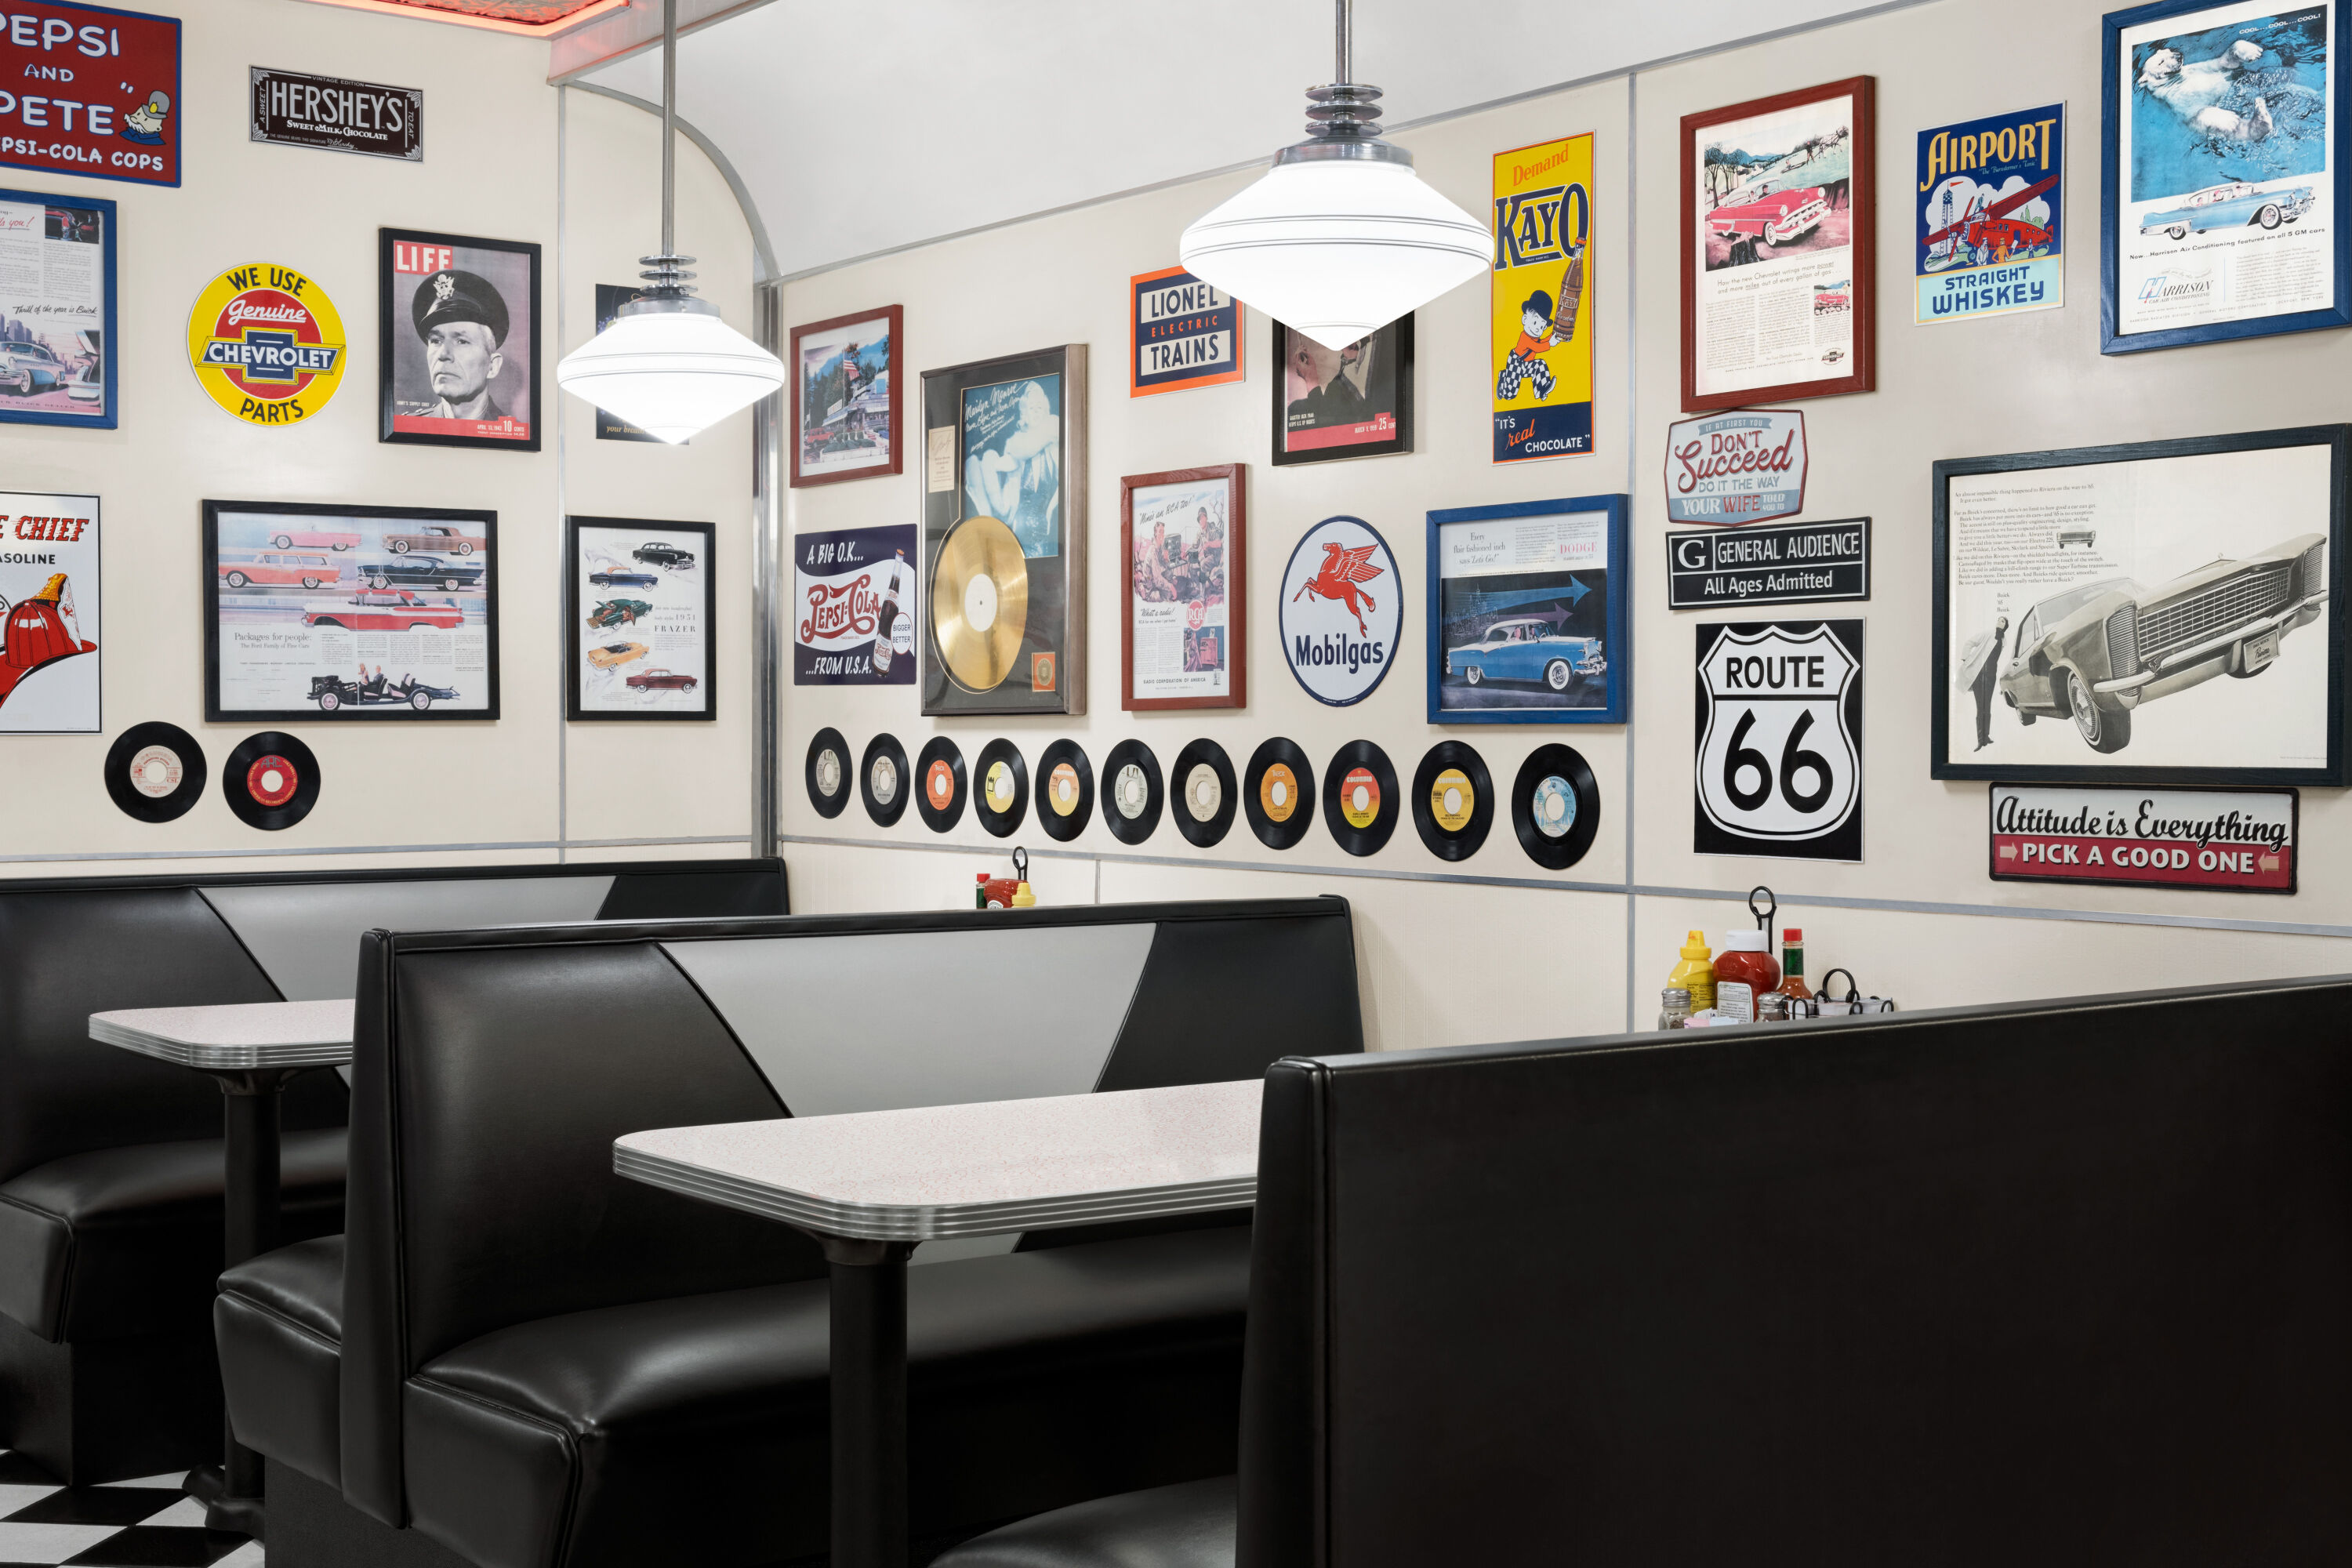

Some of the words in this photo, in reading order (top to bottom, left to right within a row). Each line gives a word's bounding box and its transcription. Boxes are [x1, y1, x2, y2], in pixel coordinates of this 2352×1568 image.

[0, 12, 119, 57] EPSI
[24, 64, 74, 82] AND
[312, 75, 338, 84] VINTAGE
[271, 81, 403, 132] HERSHEY'S
[408, 111, 414, 122] TO
[287, 120, 314, 130] SWEET
[314, 124, 342, 134] MILK
[343, 127, 388, 140] CHOCOLATE
[0, 136, 102, 164] PSI-COLA
[111, 151, 163, 171] COPS
[1512, 143, 1569, 187] Demand
[1919, 118, 2056, 192] AIRPORT
[1494, 183, 1588, 271] KAYO
[2192, 241, 2235, 251] Conditioning
[2238, 235, 2264, 245] featured
[396, 244, 451, 272] LIFE
[226, 267, 260, 292] WE
[270, 267, 307, 297] USE
[1745, 282, 1759, 291] miles
[1795, 273, 1813, 281] gallon
[1754, 271, 1780, 280] Chevrolet
[1945, 265, 2030, 291] STRAIGHT
[13, 305, 33, 314] Thrill
[34, 305, 42, 314] of
[76, 306, 97, 314] Buick
[1151, 285, 1218, 318] LIONEL
[1933, 280, 2044, 314] WHISKEY
[228, 299, 307, 325] Genuine
[1151, 315, 1218, 338] ELECTRIC
[209, 343, 331, 368] CHEVROLET
[1150, 333, 1218, 370] TRAINS
[239, 397, 304, 423] PARTS
[964, 400, 989, 422] Marilyn
[990, 382, 1028, 406] Monroe
[503, 420, 512, 432] 10
[1379, 417, 1387, 430] 25
[1505, 418, 1535, 451] real
[1715, 421, 1725, 430] AT
[1726, 419, 1746, 428] FIRST
[1750, 418, 1763, 426] YOU
[1711, 430, 1762, 455] DON'T
[1674, 428, 1795, 494] Succeed
[1698, 481, 1715, 493] DO
[1718, 480, 1727, 492] IT
[1732, 478, 1753, 490] THE
[1757, 476, 1780, 489] WAY
[1166, 501, 1179, 514] RCA
[1682, 497, 1721, 516] YOUR
[1722, 495, 1761, 514] WIFE
[1762, 493, 1786, 503] TOLD
[1762, 503, 1776, 511] YOU
[15, 515, 89, 542] CHIEF
[1470, 532, 1484, 543] Every
[807, 545, 814, 564] A
[818, 543, 834, 564] BIG
[1494, 541, 1505, 551] inch
[1559, 542, 1597, 554] DODGE
[1678, 539, 1707, 569] G
[1717, 538, 1781, 564] GENERAL
[1787, 532, 1860, 559] AUDIENCE
[1704, 578, 1725, 595] All
[1728, 576, 1762, 597] Ages
[1766, 570, 1832, 592] Admitted
[1188, 608, 1203, 622] RCA
[234, 632, 269, 642] Packages
[272, 632, 282, 641] for
[285, 633, 311, 642] people:
[844, 655, 872, 674] U.S.A.
[1296, 633, 1384, 674] Mobilgas
[1726, 655, 1824, 689] ROUTE
[1723, 707, 1834, 814] 66
[1996, 795, 2101, 834] Attitude
[2107, 809, 2129, 835] is
[2134, 799, 2288, 852] Everything
[2022, 843, 2080, 865] PICK
[2086, 847, 2104, 866] A
[2111, 847, 2190, 870] GOOD
[2198, 850, 2255, 873] ONE
